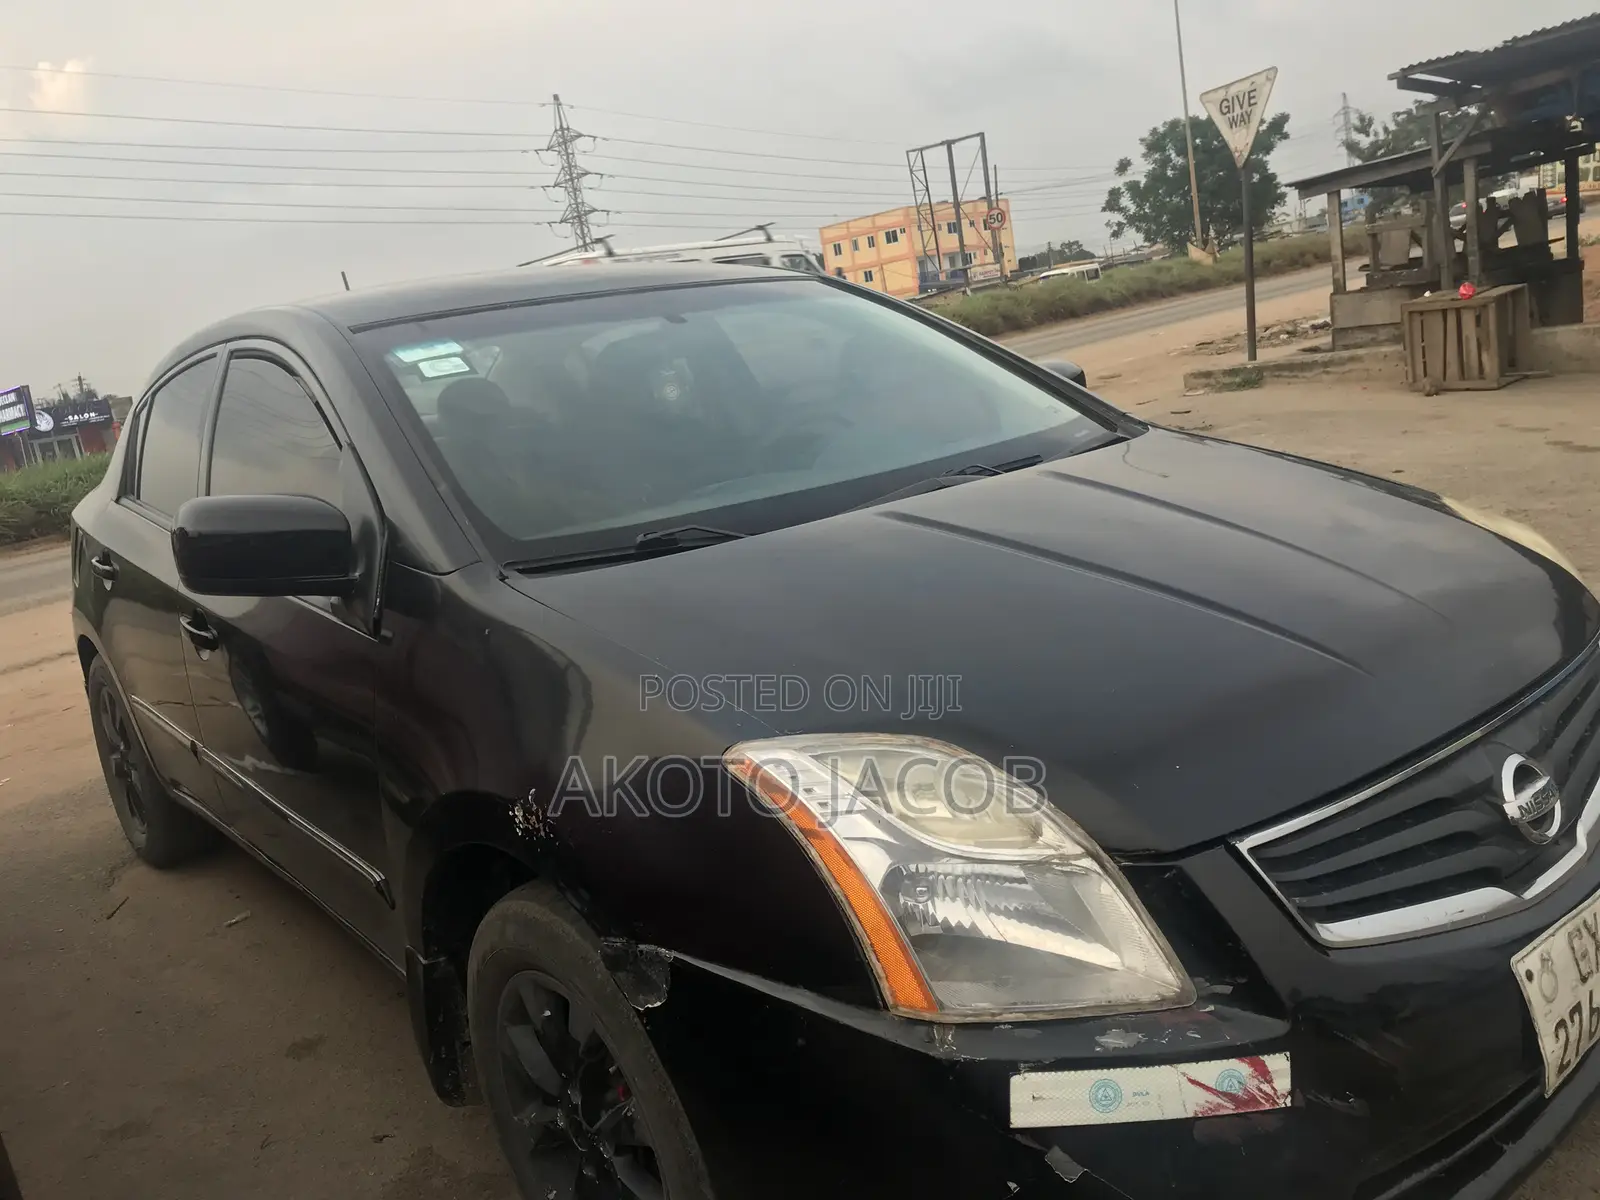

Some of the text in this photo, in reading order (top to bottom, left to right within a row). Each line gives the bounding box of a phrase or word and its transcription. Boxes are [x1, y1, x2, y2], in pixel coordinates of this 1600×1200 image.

[1219, 89, 1258, 116] GIVE
[1227, 109, 1253, 129] WAY
[988, 212, 1003, 225] 50
[68, 412, 95, 421] SALON
